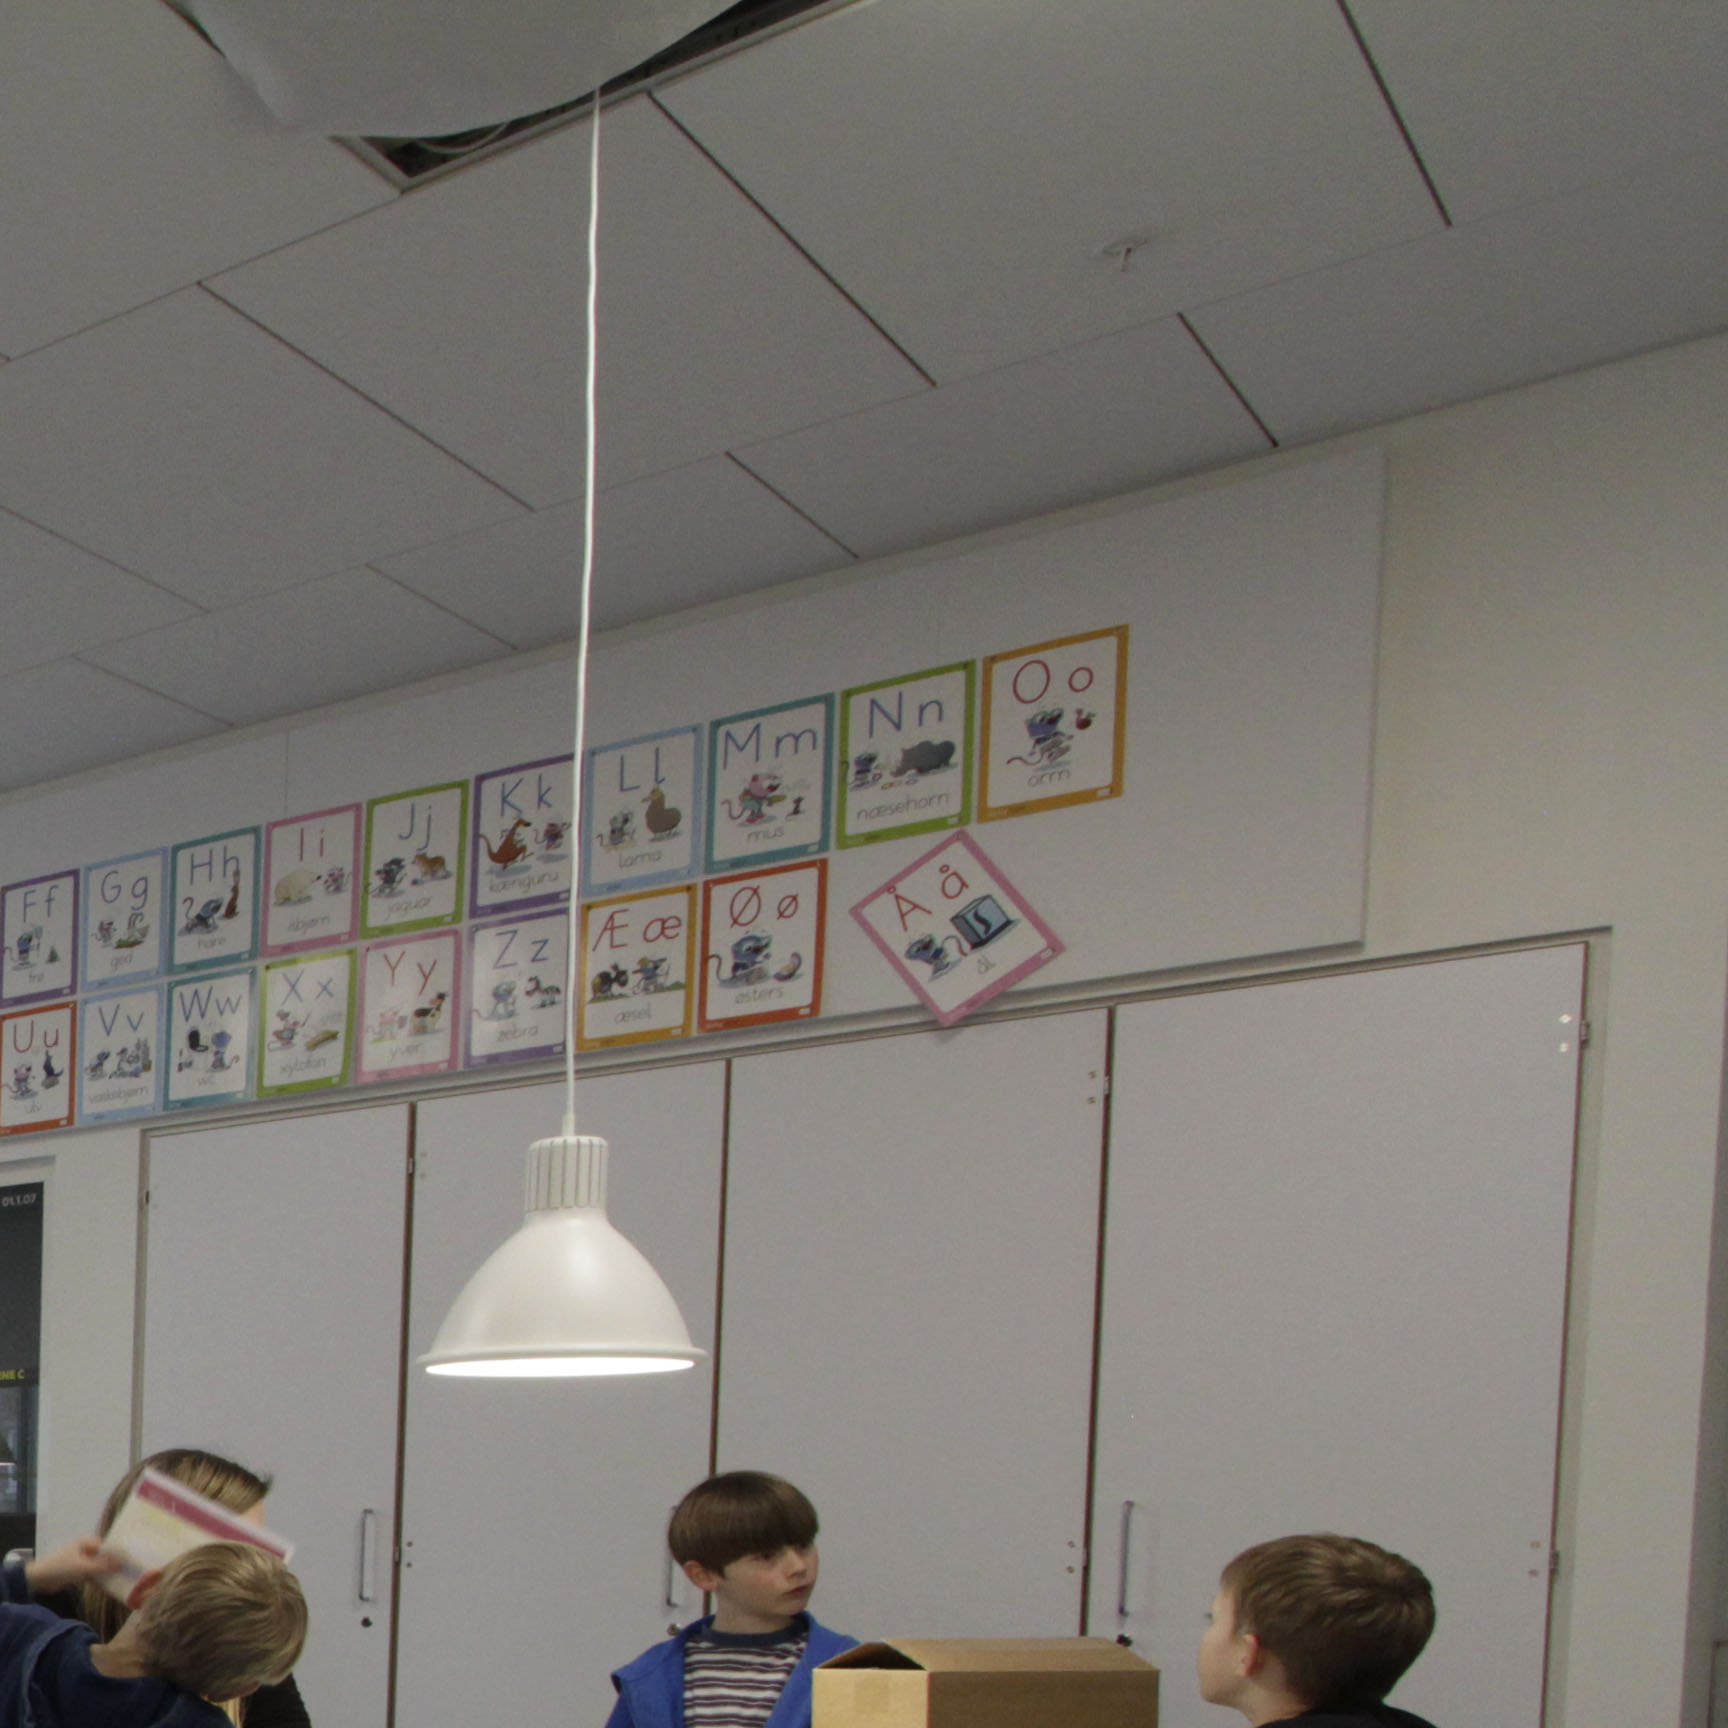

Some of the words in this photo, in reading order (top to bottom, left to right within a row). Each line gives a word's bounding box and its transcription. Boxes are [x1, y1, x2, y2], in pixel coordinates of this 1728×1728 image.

[1028, 769, 1071, 788] orm
[856, 792, 949, 821] næsehorn
[747, 826, 784, 843] mus
[618, 851, 662, 870] lama
[614, 1007, 652, 1025] æsel
[497, 1024, 539, 1043] zebra
[17, 1368, 25, 1380] C
